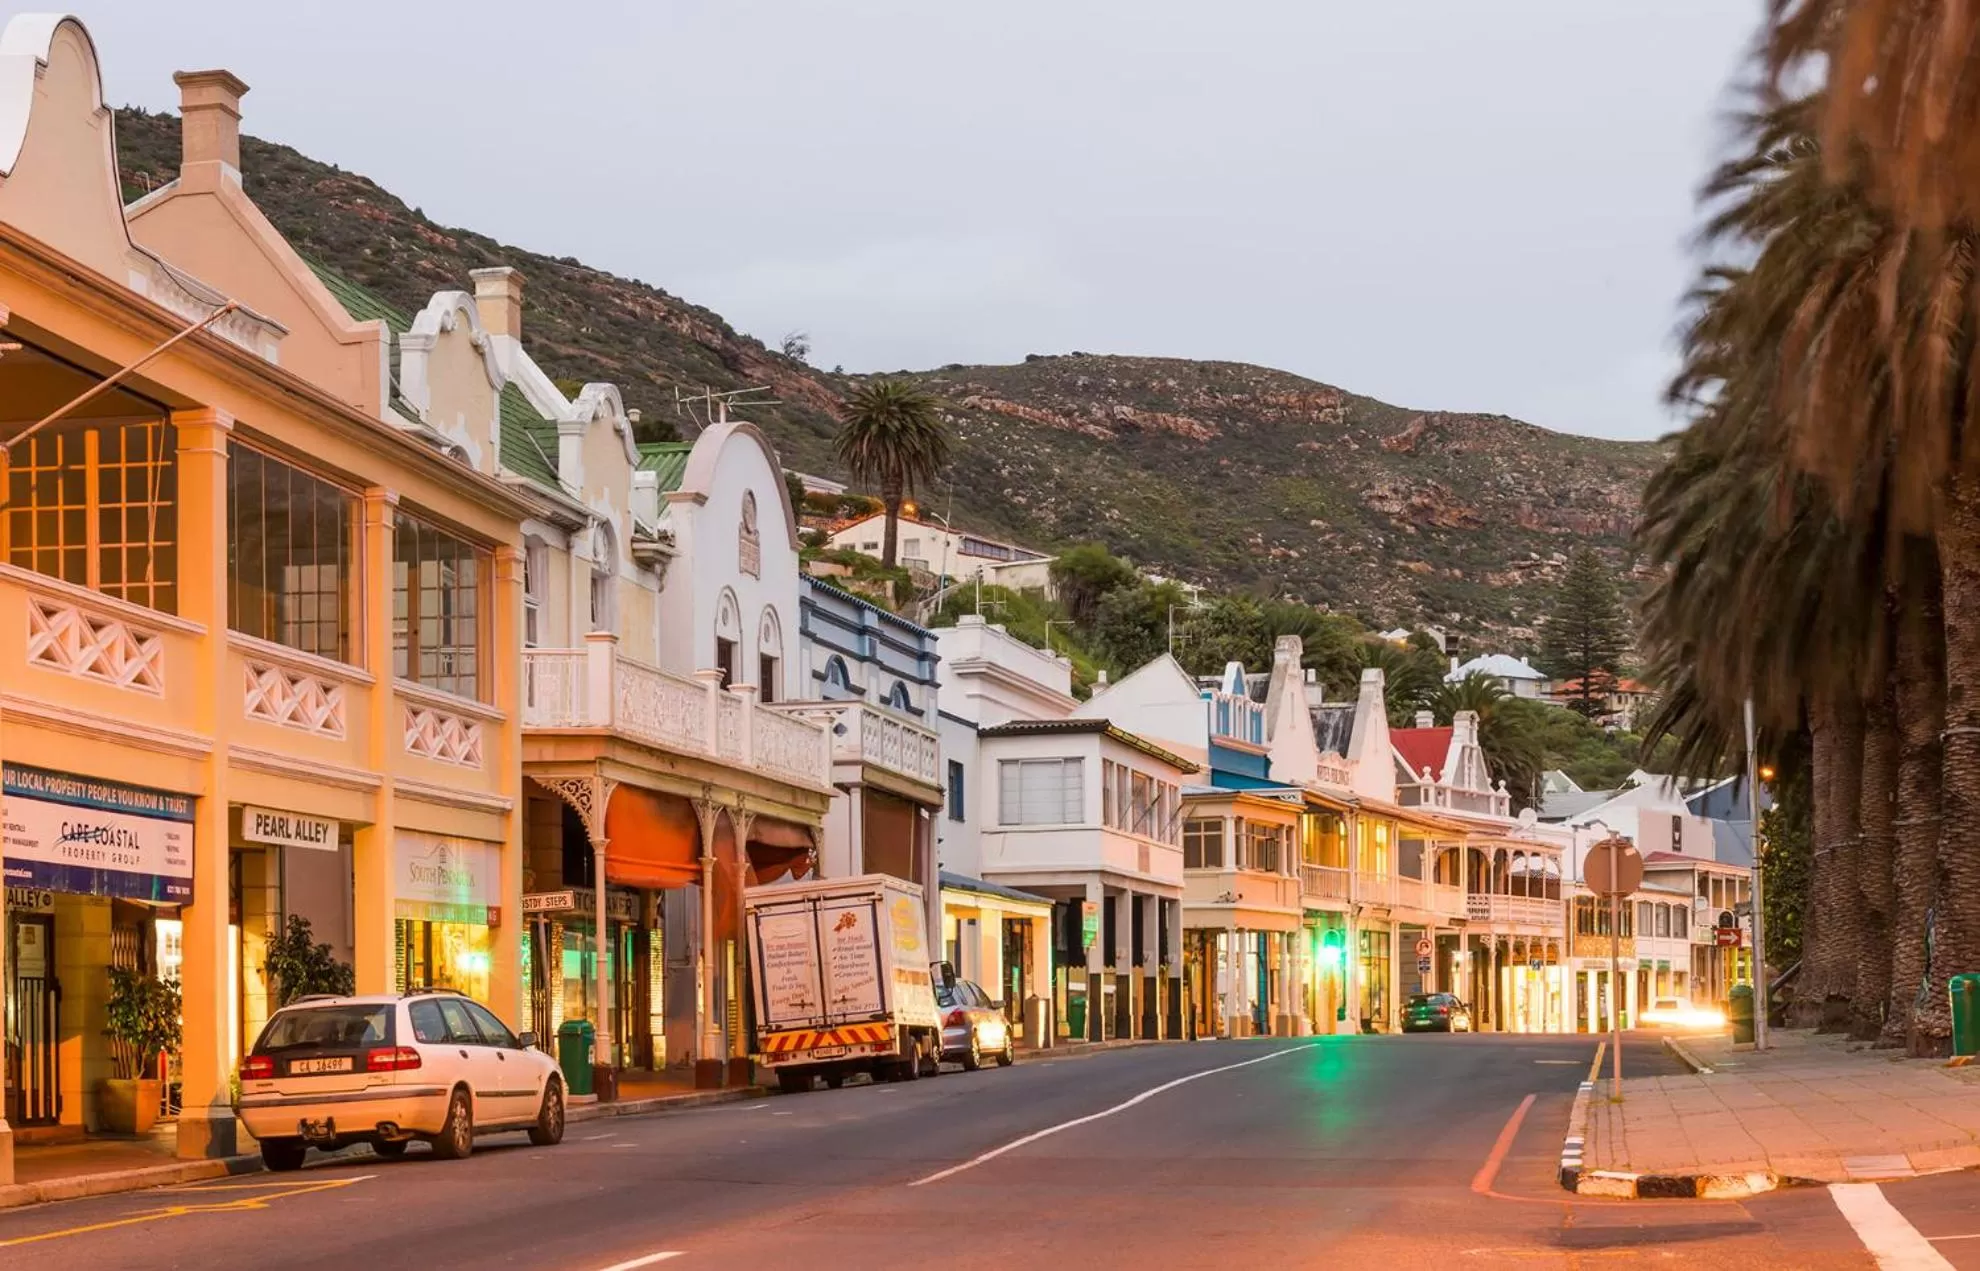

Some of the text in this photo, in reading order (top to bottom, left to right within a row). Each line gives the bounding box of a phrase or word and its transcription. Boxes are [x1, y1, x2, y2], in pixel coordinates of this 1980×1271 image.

[4, 768, 16, 786] UR
[17, 771, 44, 791] LOCAL
[45, 776, 88, 798] PROPERTY
[88, 783, 116, 804] PEOPLE
[116, 789, 133, 806] YOU
[134, 792, 158, 810] KNOW
[165, 796, 187, 814] TRUST
[61, 821, 140, 850] CAPE COASTAL
[255, 813, 329, 844] PEARL ALLEY
[63, 846, 140, 865] PROPERTY GROUP
[7, 888, 40, 908] ALLEY
[523, 895, 567, 909] STDY STEPS
